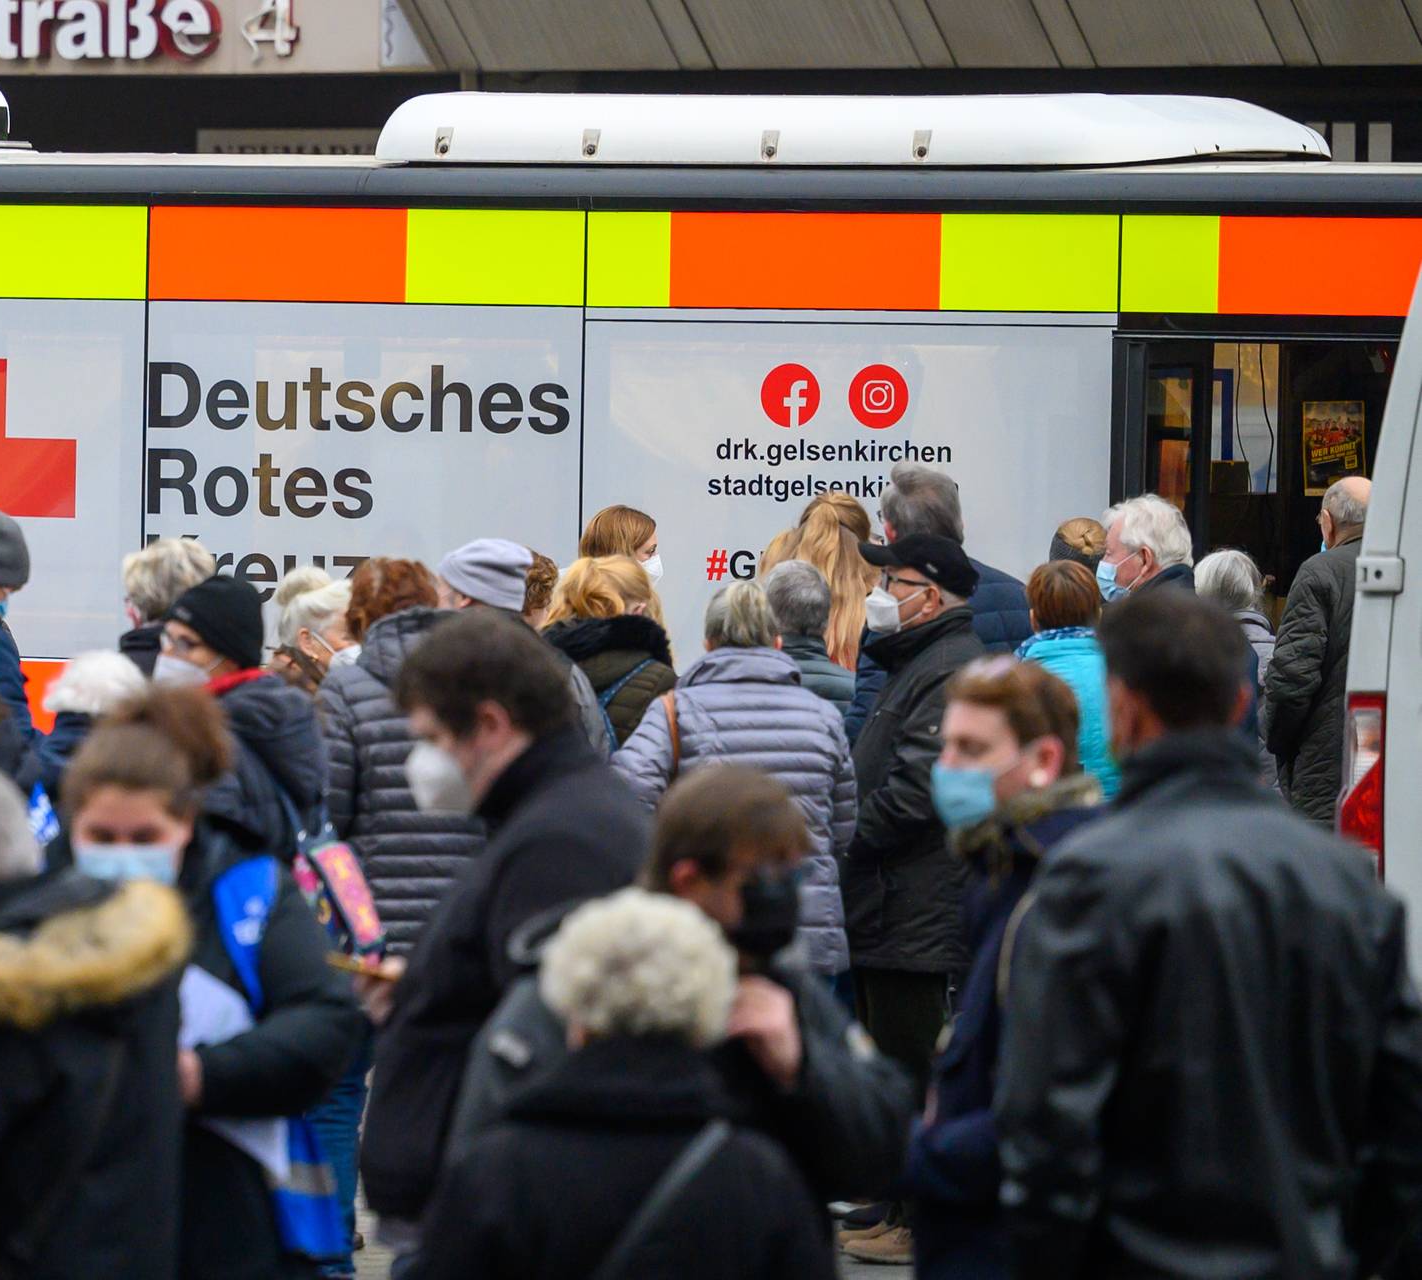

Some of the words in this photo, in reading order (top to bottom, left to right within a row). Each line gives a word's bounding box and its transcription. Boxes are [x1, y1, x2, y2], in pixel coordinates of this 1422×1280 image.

[147, 361, 571, 435] Deutsches
[716, 438, 952, 466] drk.gelsenkirchen
[146, 447, 374, 519] Rotes
[708, 474, 959, 502] stadtgelsenki
